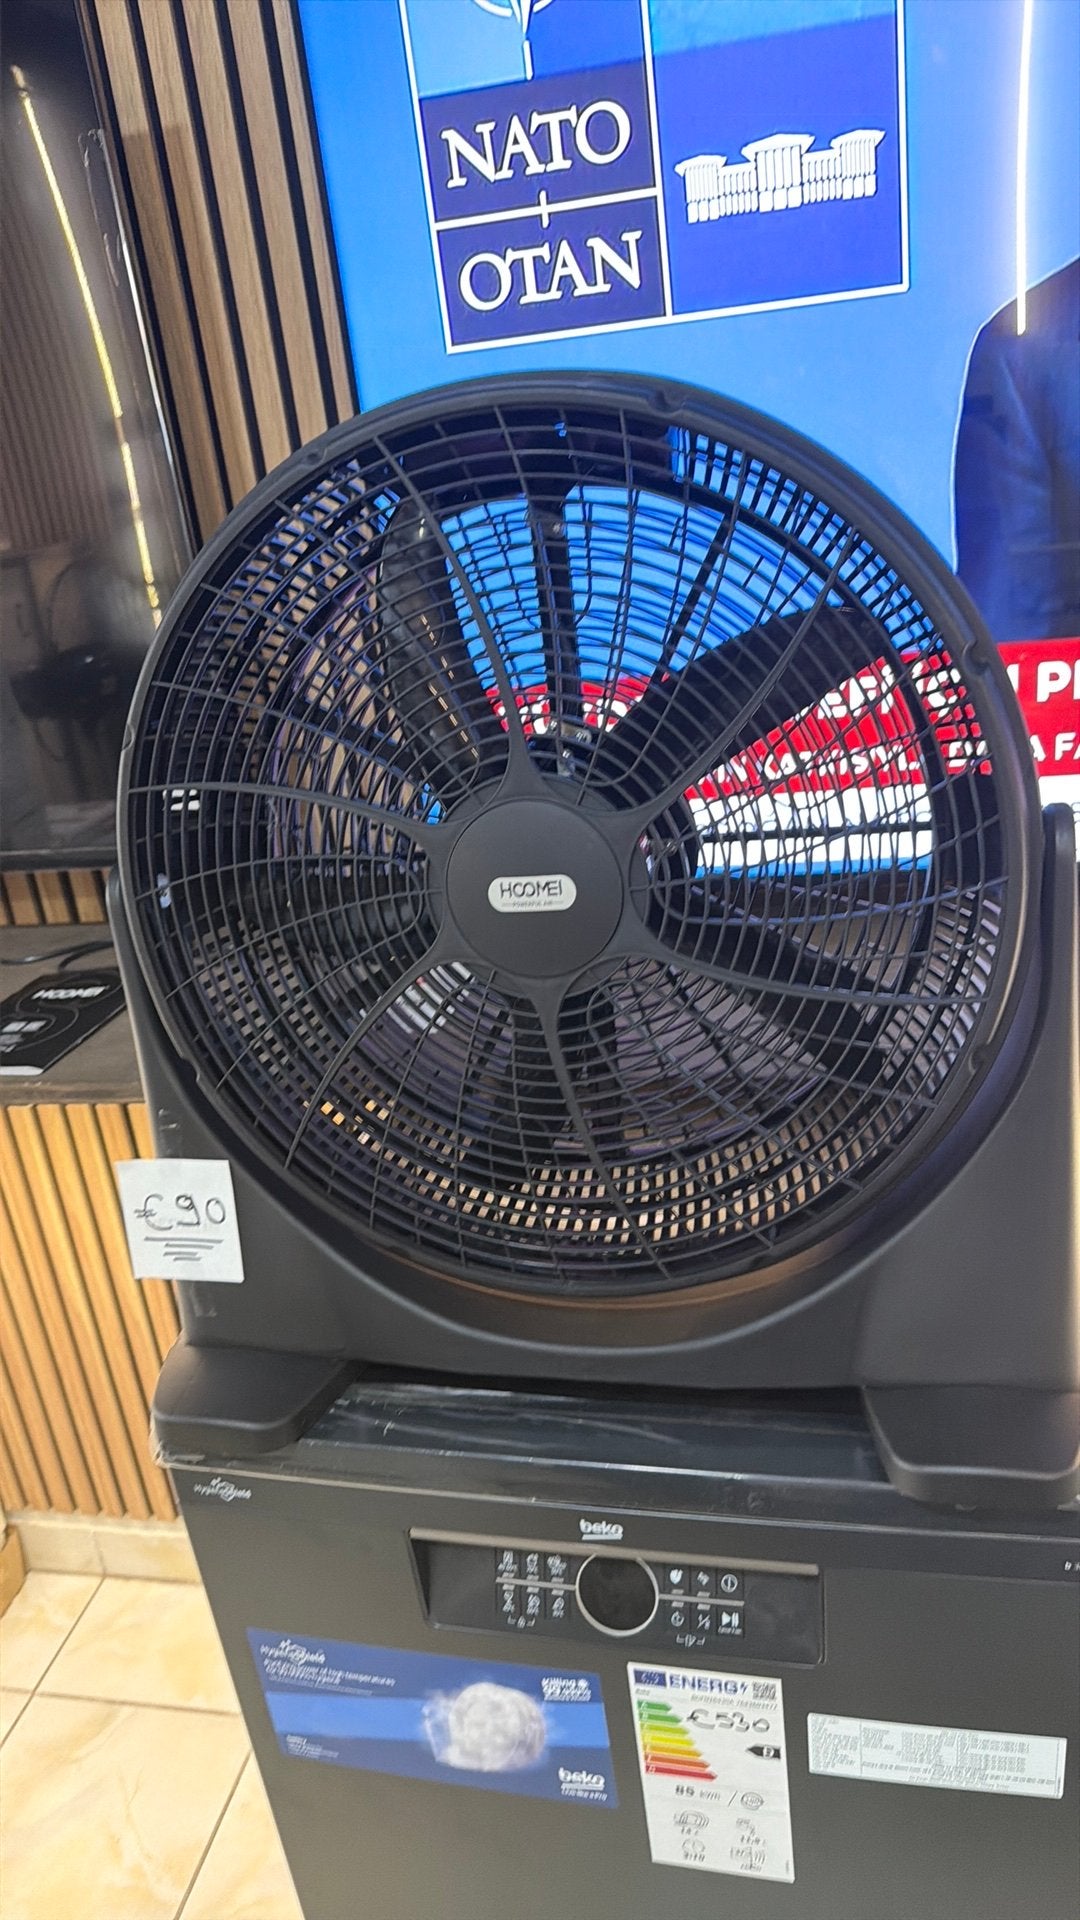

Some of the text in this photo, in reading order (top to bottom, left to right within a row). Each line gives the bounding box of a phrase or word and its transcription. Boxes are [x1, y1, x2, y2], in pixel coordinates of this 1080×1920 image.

[441, 101, 631, 188] NATO
[459, 230, 642, 311] OTAN
[500, 879, 562, 899] HOOMEI
[134, 1194, 226, 1231] €90
[579, 1518, 624, 1536] beko
[558, 1767, 605, 1787] beko
